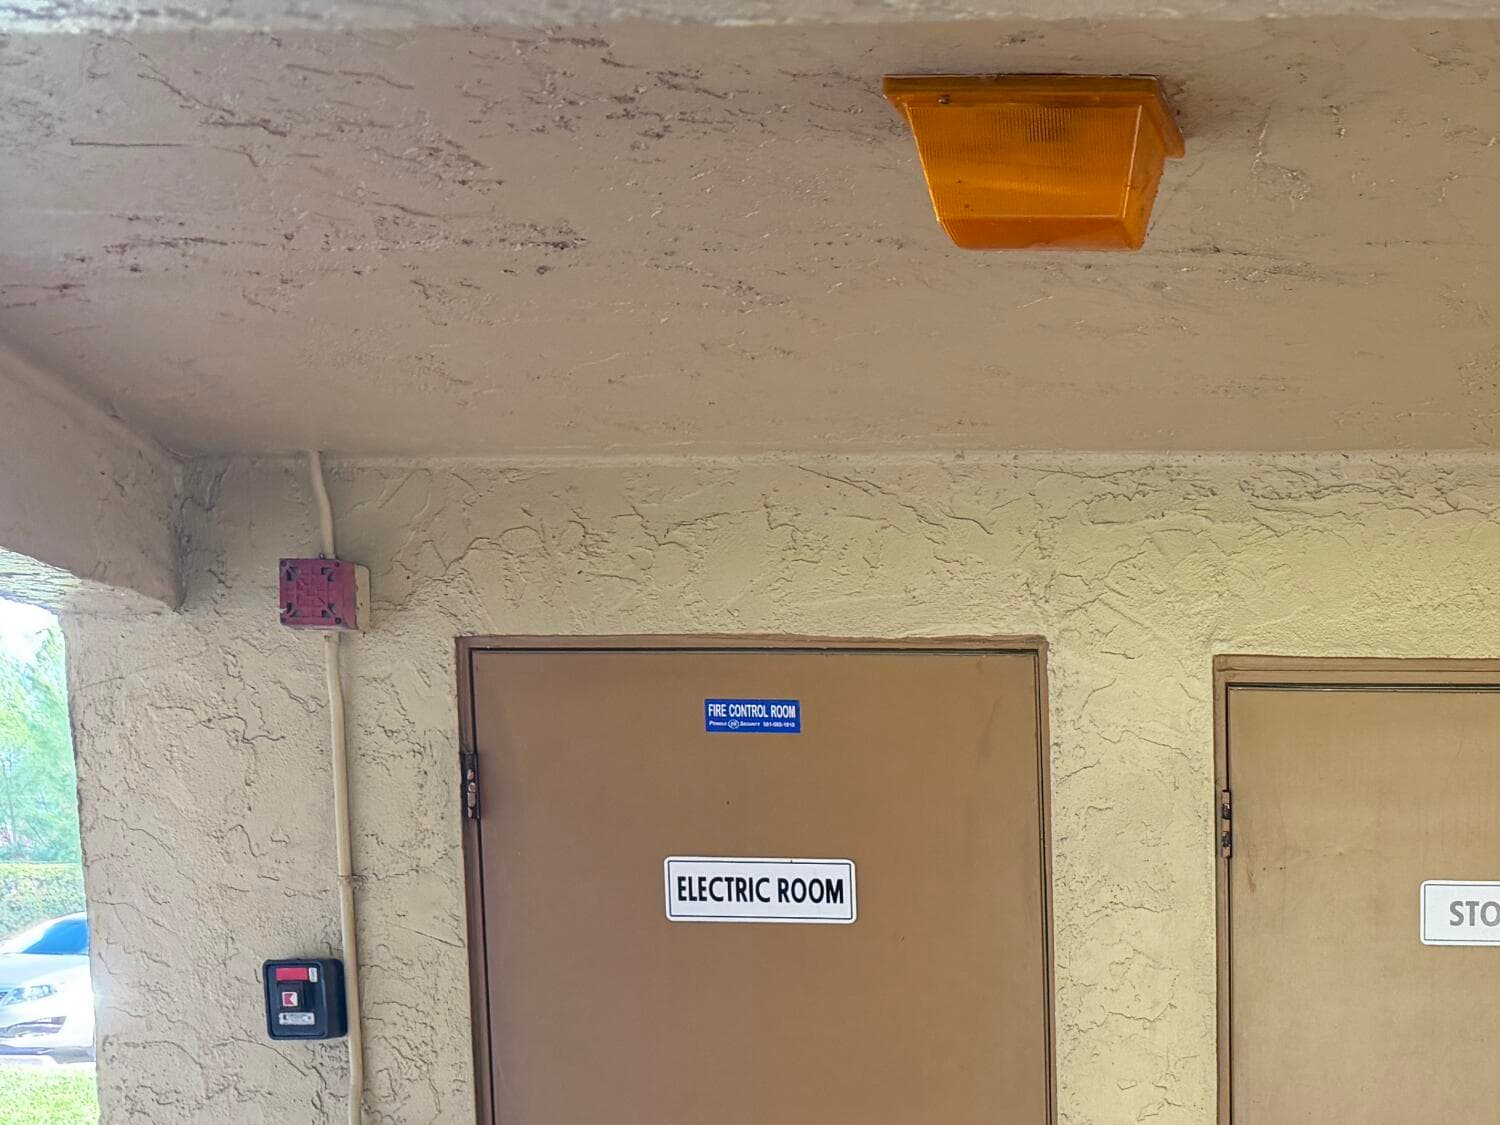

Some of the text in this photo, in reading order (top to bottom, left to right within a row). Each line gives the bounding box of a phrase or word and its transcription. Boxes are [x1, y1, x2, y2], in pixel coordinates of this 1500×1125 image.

[708, 704, 796, 718] FIRE CONTROL ROOM
[677, 876, 844, 904] ELECTRIC ROOM
